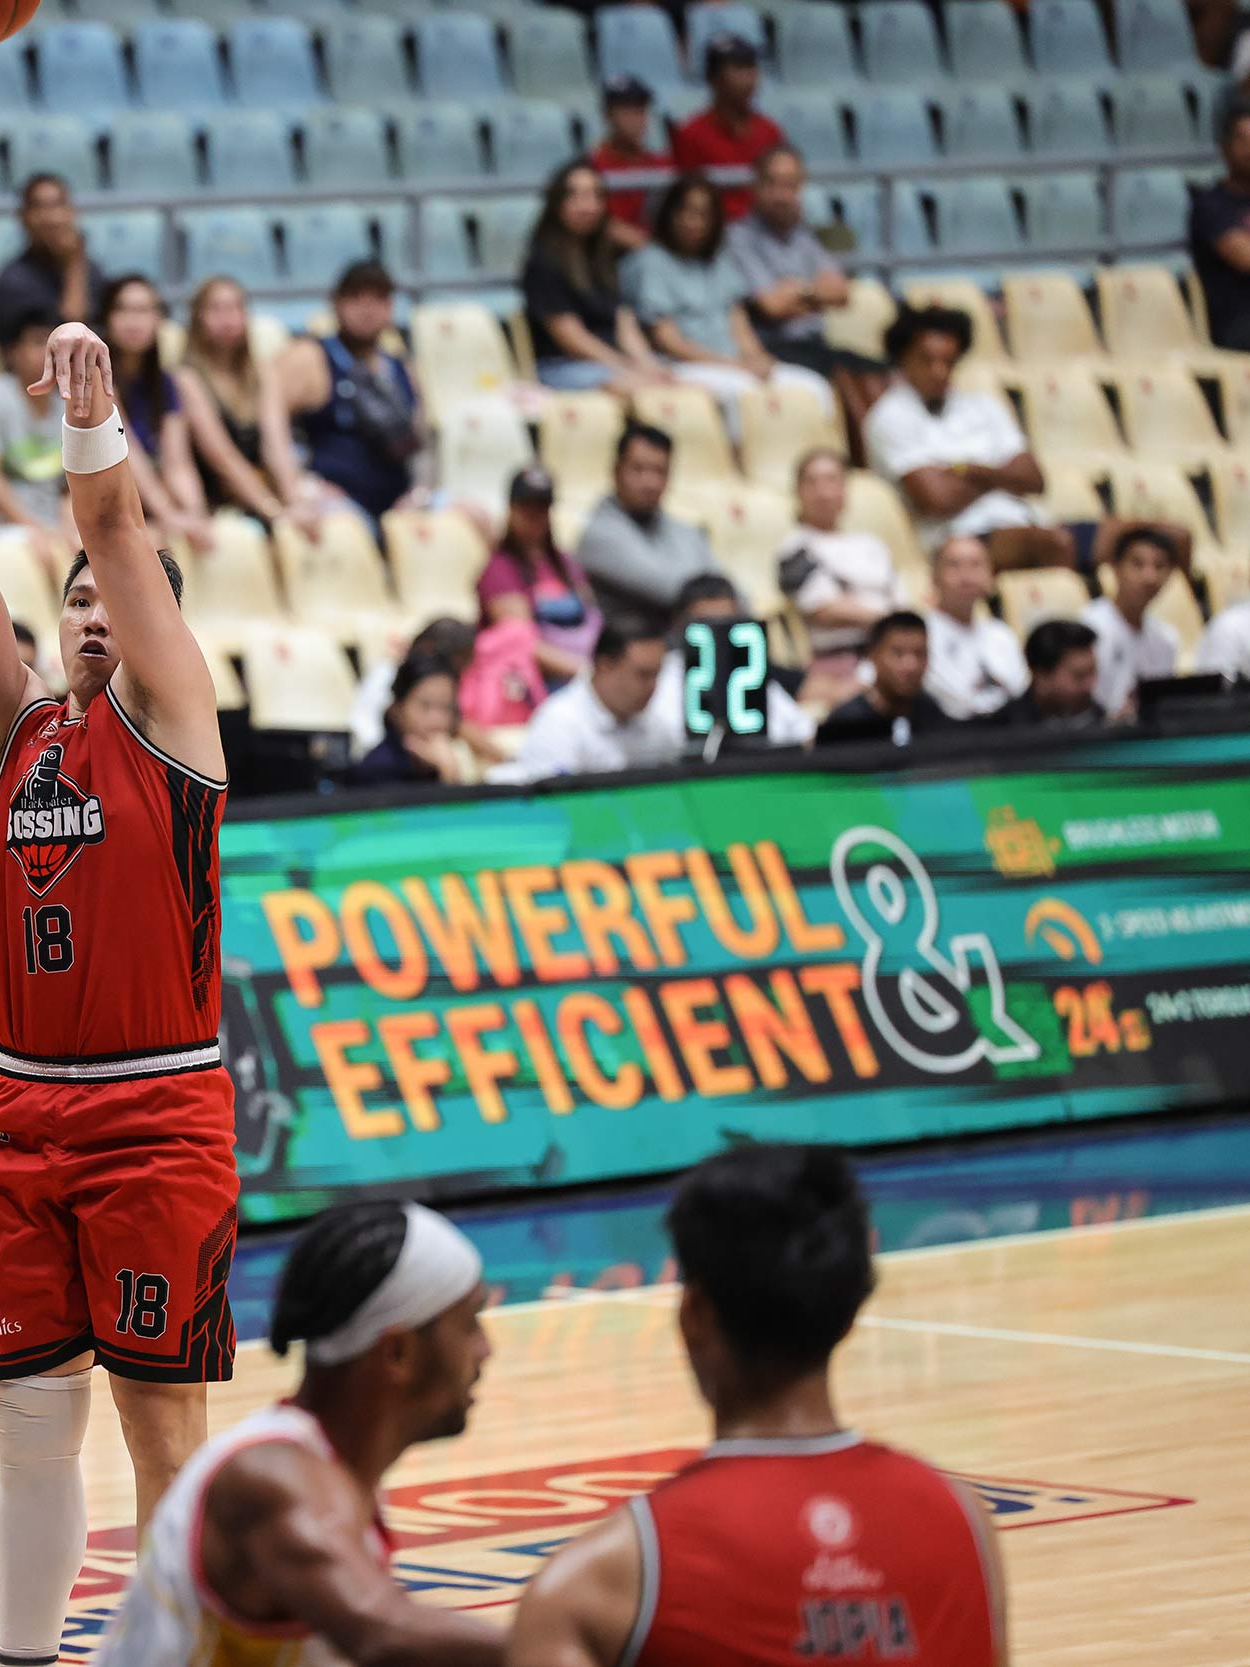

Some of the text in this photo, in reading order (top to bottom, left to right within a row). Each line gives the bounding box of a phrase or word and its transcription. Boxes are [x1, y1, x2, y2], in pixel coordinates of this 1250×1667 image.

[685, 622, 766, 734] 22
[22, 903, 75, 975] 18
[261, 840, 846, 1008] POWERFUL
[830, 825, 1041, 1074] &
[310, 963, 881, 1140] EFFICIENT
[115, 1268, 170, 1339] 18
